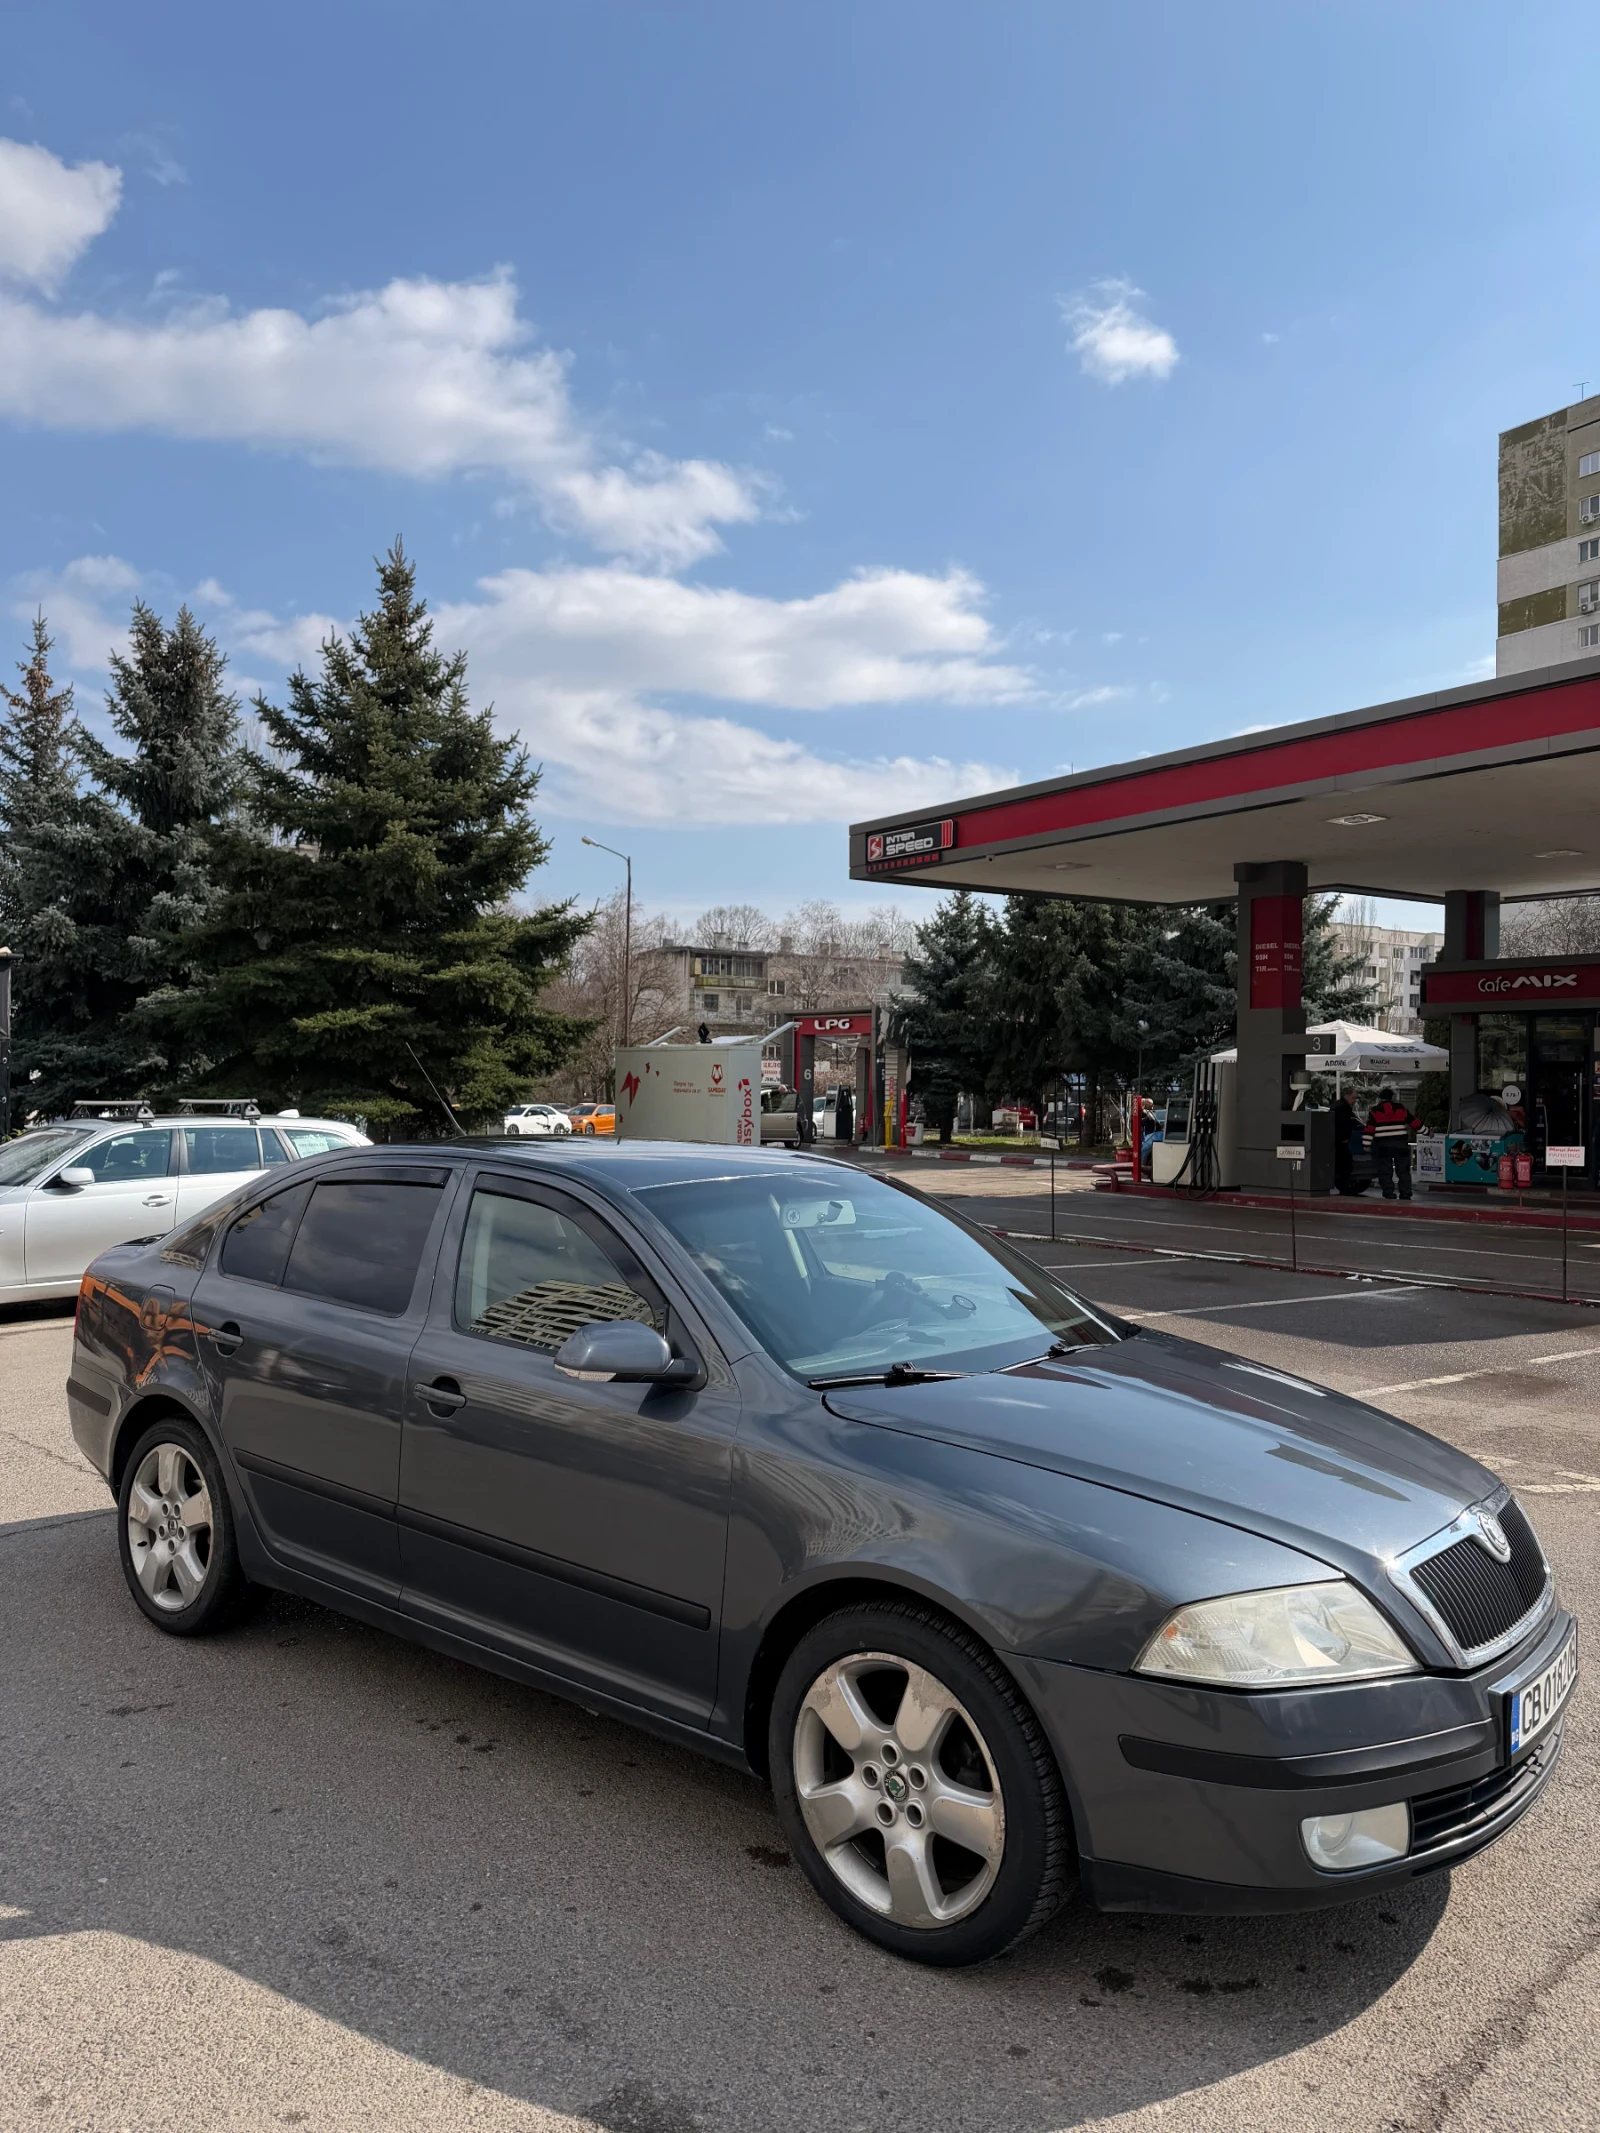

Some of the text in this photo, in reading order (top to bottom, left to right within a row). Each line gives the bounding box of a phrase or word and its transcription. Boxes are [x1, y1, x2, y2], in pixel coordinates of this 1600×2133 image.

[886, 832, 915, 844] INTER
[886, 837, 933, 855] SPEED
[1255, 942, 1279, 950] DIESEL
[1283, 942, 1301, 950] DIESEL
[1255, 965, 1267, 973] TIR
[1478, 973, 1578, 993] Cafe MIX
[814, 1018, 850, 1031] LPG
[1312, 1036, 1321, 1052] 3
[1325, 1059, 1347, 1067] ADORE
[803, 1068, 812, 1080] 6
